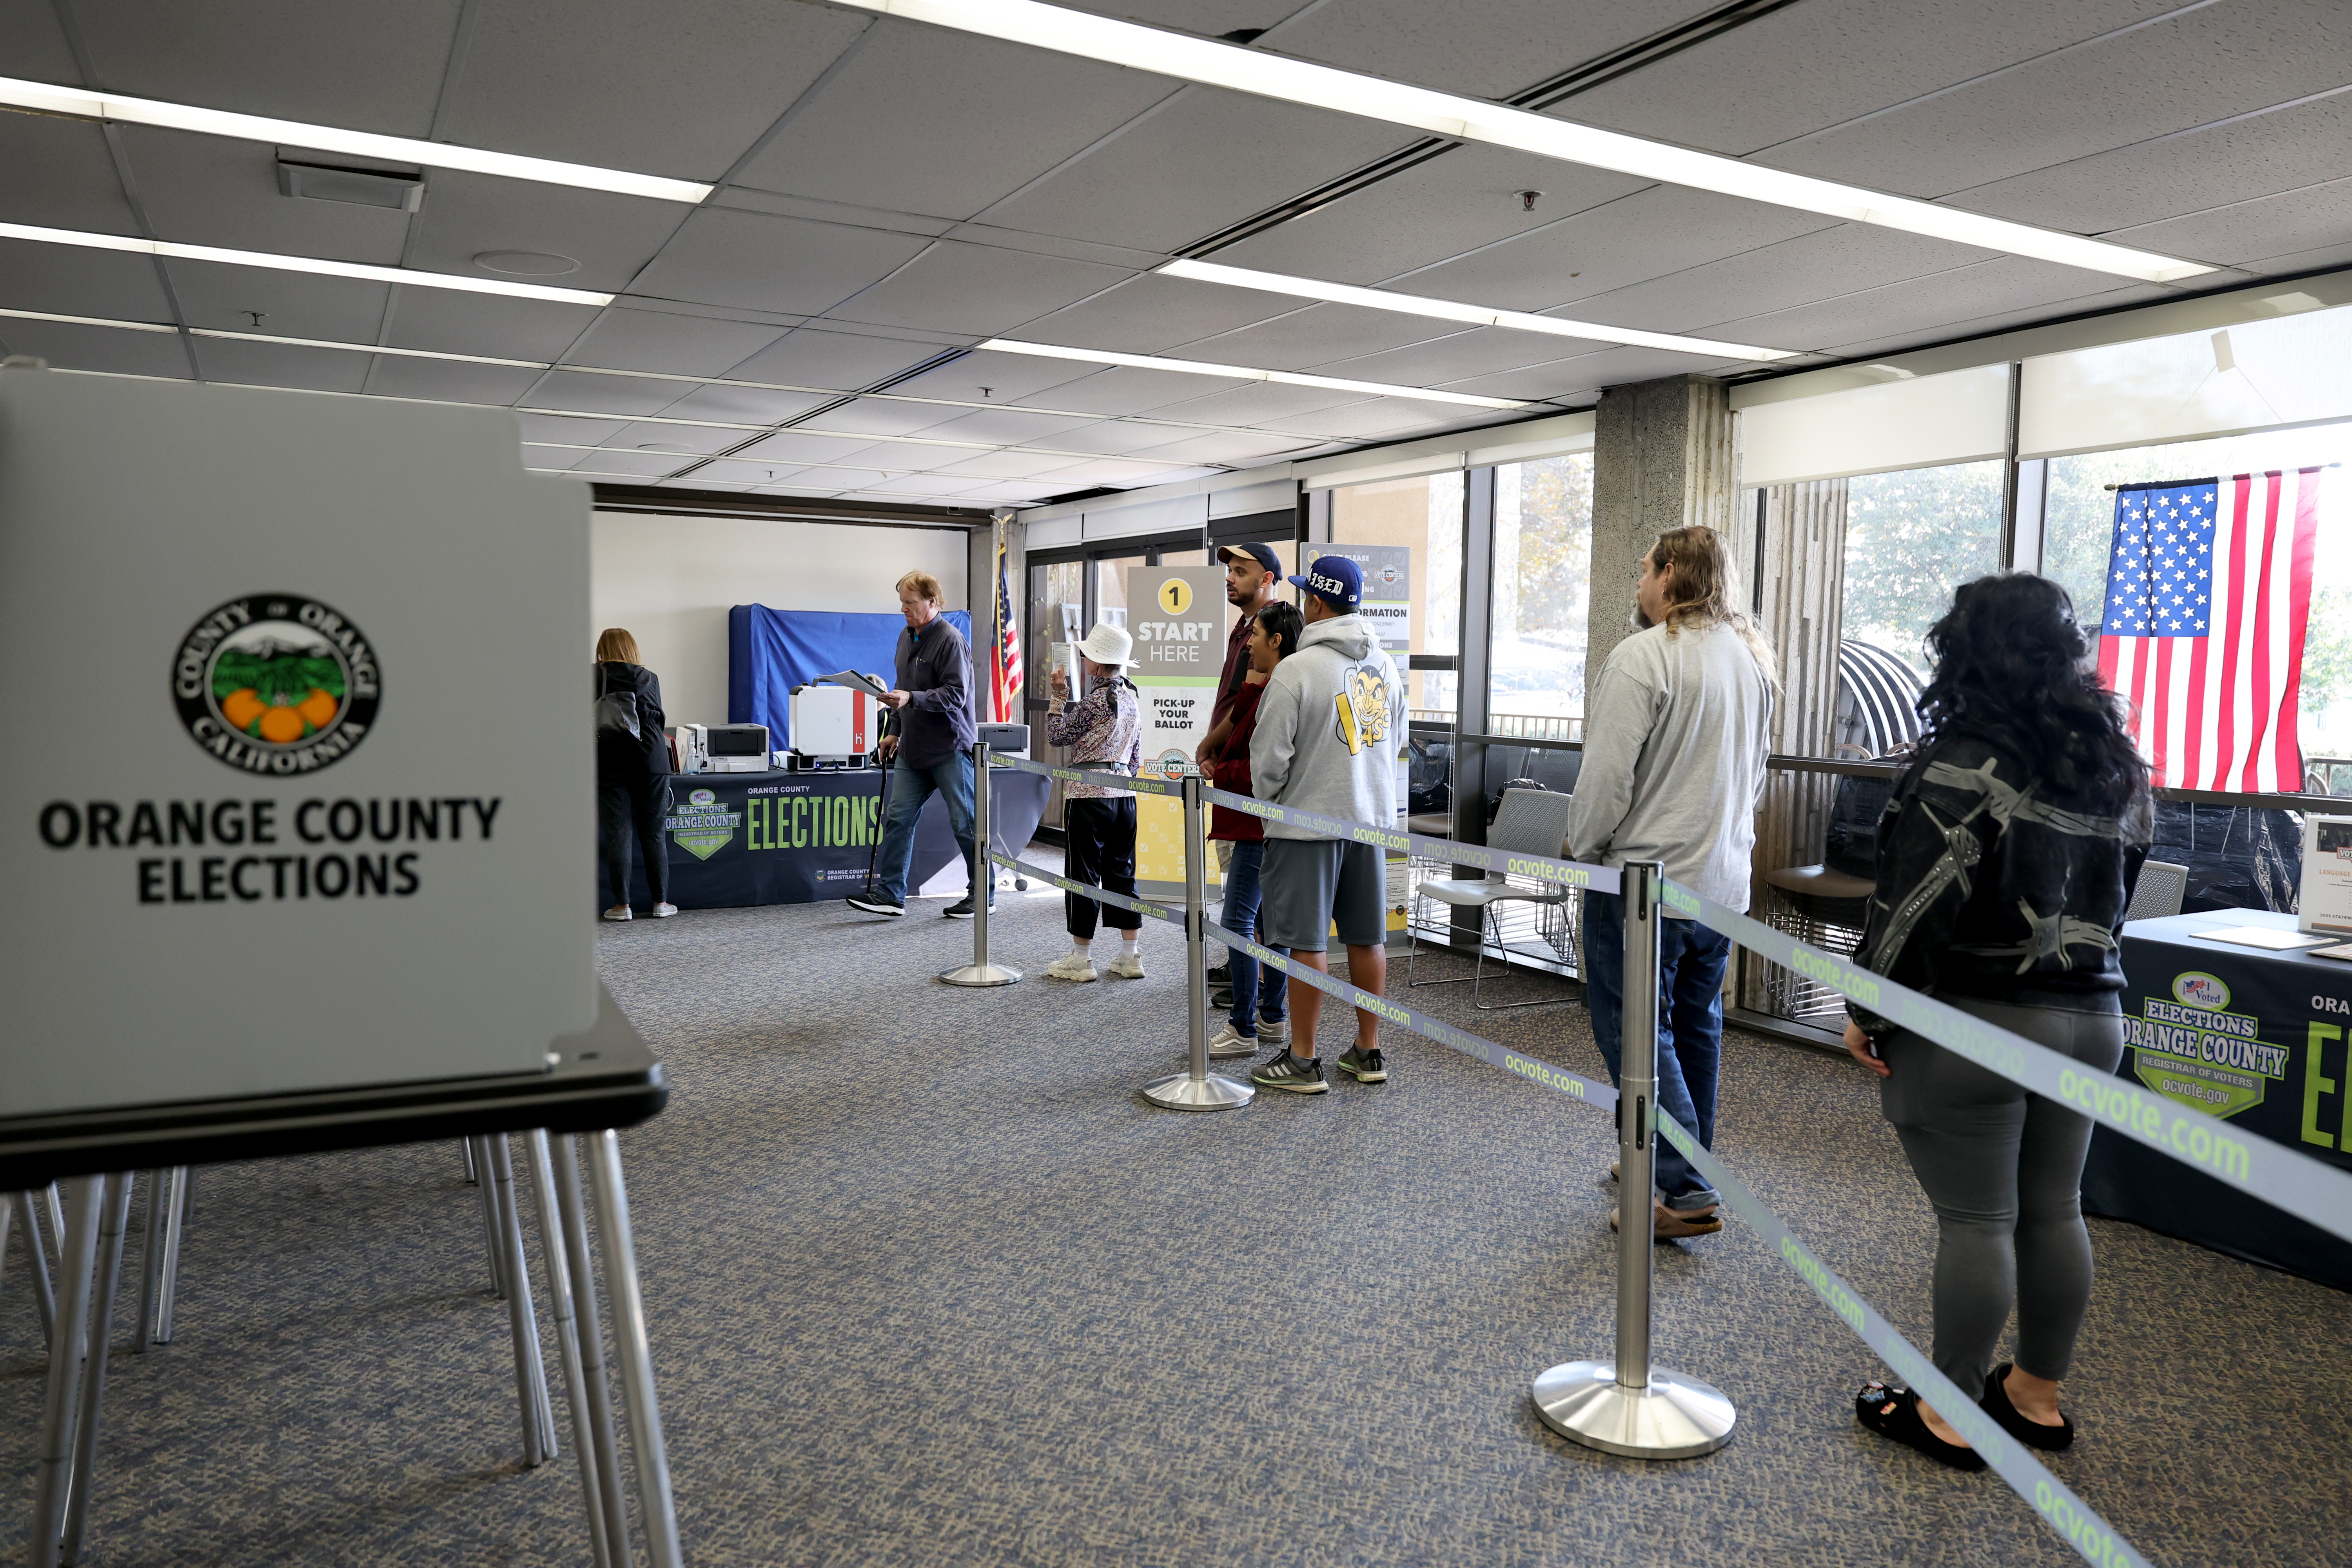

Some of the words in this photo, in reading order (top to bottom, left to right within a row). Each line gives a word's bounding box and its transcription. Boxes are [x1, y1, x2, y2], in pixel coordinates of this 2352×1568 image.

[1169, 586, 1178, 606] 1
[1358, 609, 1407, 617] ORMATION
[1138, 621, 1213, 641] START
[176, 600, 251, 699] COUNTY
[299, 603, 378, 699] ORANGE
[1150, 645, 1200, 662] HERE
[1153, 699, 1195, 708] PICK-UP
[1159, 710, 1189, 718] YOUR
[1155, 720, 1193, 729] BALLOT
[192, 716, 366, 774] CALIFORNIA
[991, 754, 1015, 767] ocvote.com
[1161, 751, 1174, 761] ORANGE
[1175, 751, 1189, 762] COUNTY
[1053, 768, 1082, 782] ocvote.com
[1146, 762, 1167, 772] VOTE
[1128, 780, 1165, 793] ocvote.com
[678, 805, 727, 815] ELECTIONS
[1242, 800, 1283, 821] ocvote.com
[38, 799, 278, 851] ORANGE
[294, 796, 503, 844] COUNTY
[665, 816, 703, 830] ORANGE
[705, 814, 740, 828] COUNTY
[748, 796, 884, 850] ELECTIONS
[1354, 827, 1410, 851] ocvote.com
[992, 853, 1016, 870] ocvote.com
[137, 851, 421, 905] ELECTIONS
[1508, 858, 1589, 886] ocvote.com
[2319, 869, 2350, 877] LANGUAGE
[1054, 877, 1084, 894] ocvote.com
[1130, 901, 1167, 920] ocvote.com
[1246, 943, 1287, 971] ocvote.com
[1792, 947, 1879, 1007] ocvote.com
[2207, 982, 2210, 991] I
[2196, 989, 2220, 1004] Voted
[2311, 995, 2352, 1015] ORA
[1355, 992, 1410, 1026] ocvote.com
[2146, 1000, 2256, 1037] ELECTIONS
[2122, 1017, 2198, 1057] ORANGE
[2201, 1033, 2286, 1076] COUNTY
[1505, 1054, 1584, 1098] ocvote.com
[2141, 1056, 2196, 1074] REGISTRAR
[2198, 1068, 2211, 1077] OF
[2213, 1072, 2253, 1088] VOTERS
[2162, 1078, 2230, 1105] ocvote.gov
[2059, 1067, 2250, 1182] ocvote.com
[1781, 1236, 1865, 1332] ocvote.com
